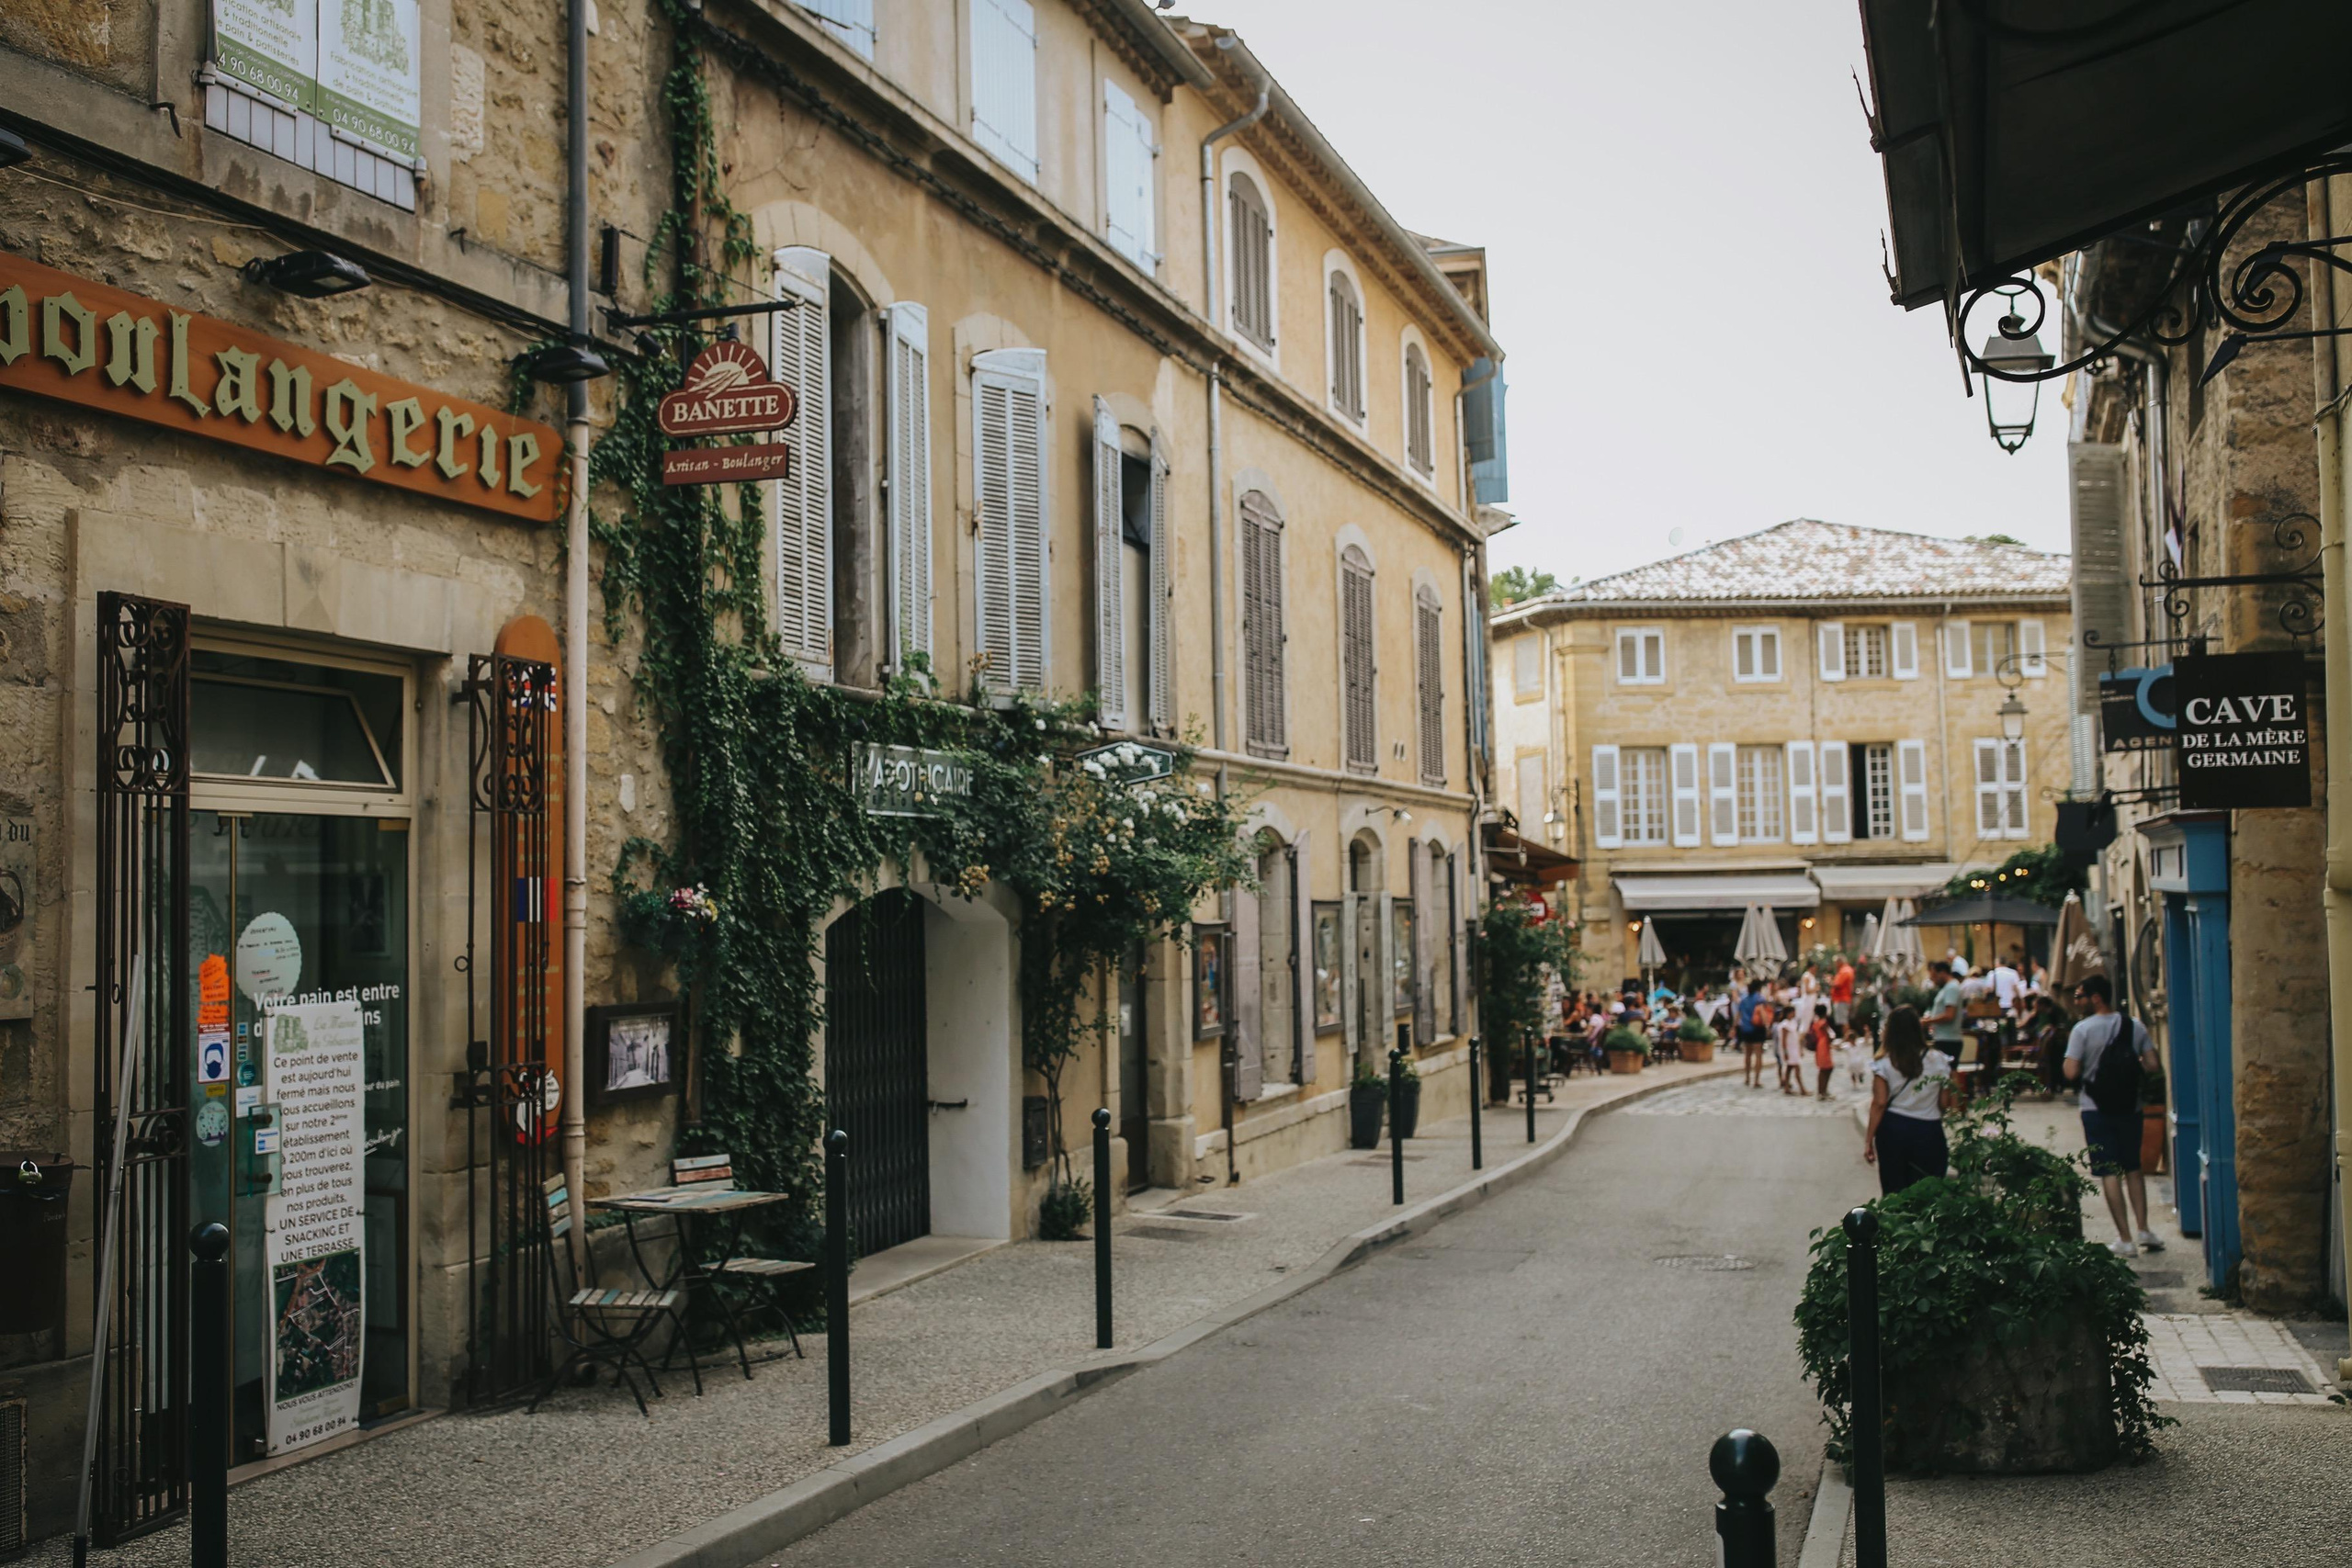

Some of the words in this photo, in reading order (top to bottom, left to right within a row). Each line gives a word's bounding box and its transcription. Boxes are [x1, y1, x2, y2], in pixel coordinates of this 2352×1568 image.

[223, 7, 230, 17] &
[232, 12, 288, 48] traditionnelle
[261, 16, 301, 42] artisanale
[225, 23, 244, 37] pain
[248, 32, 254, 41] &
[256, 39, 300, 66] patisseries
[217, 51, 226, 67] 4
[230, 56, 246, 75] 90
[249, 66, 265, 85] 68
[266, 74, 282, 93] 00
[285, 83, 299, 102] 94
[333, 107, 348, 125] 04
[351, 116, 367, 133] 90
[368, 124, 383, 141] 68
[385, 130, 399, 147] 00
[401, 138, 416, 154] 94
[672, 395, 779, 423] BANETTE
[666, 459, 709, 473] Artisan
[722, 452, 783, 471] Boulanger
[2186, 694, 2296, 726] CAVE
[2113, 736, 2177, 750] AGEN
[2182, 733, 2210, 749] DE
[2214, 732, 2242, 748] LA
[2246, 728, 2305, 746] MÈRE
[2188, 750, 2301, 769] GERMAINE
[254, 992, 296, 1012] Votre
[335, 985, 358, 1002] est
[362, 983, 401, 1002] entre
[274, 1056, 288, 1068] Ce
[290, 1055, 314, 1069] point
[317, 1053, 329, 1065] de
[332, 1051, 359, 1063] vente
[281, 1072, 296, 1084] est
[299, 1066, 351, 1085] aujourd'hui
[277, 1087, 305, 1100] fermé
[307, 1084, 331, 1096] mais
[333, 1082, 356, 1094] nous
[279, 1105, 300, 1116] ous
[302, 1097, 356, 1113] accueillons
[285, 1122, 300, 1132] sur
[302, 1117, 327, 1129] notre
[283, 1129, 350, 1148] établissement
[289, 1150, 317, 1164] 200m
[318, 1147, 338, 1160] d'ici
[340, 1145, 353, 1156] où
[280, 1187, 294, 1197] en
[296, 1181, 315, 1197] plus
[317, 1179, 329, 1191] de
[332, 1177, 353, 1188] tous
[287, 1201, 304, 1213] nos
[279, 1218, 296, 1230] UN
[299, 1209, 338, 1227] SERVICE
[341, 1206, 355, 1218] DE
[285, 1225, 336, 1247] SNACKING
[338, 1223, 351, 1235] ET
[280, 1247, 303, 1262] UNE
[307, 1237, 355, 1258] TERRASSE
[277, 1398, 298, 1412] NOUS
[299, 1393, 317, 1405] VOUS
[286, 1433, 298, 1445] 04
[299, 1428, 311, 1441] 90
[324, 1419, 336, 1432] 00
